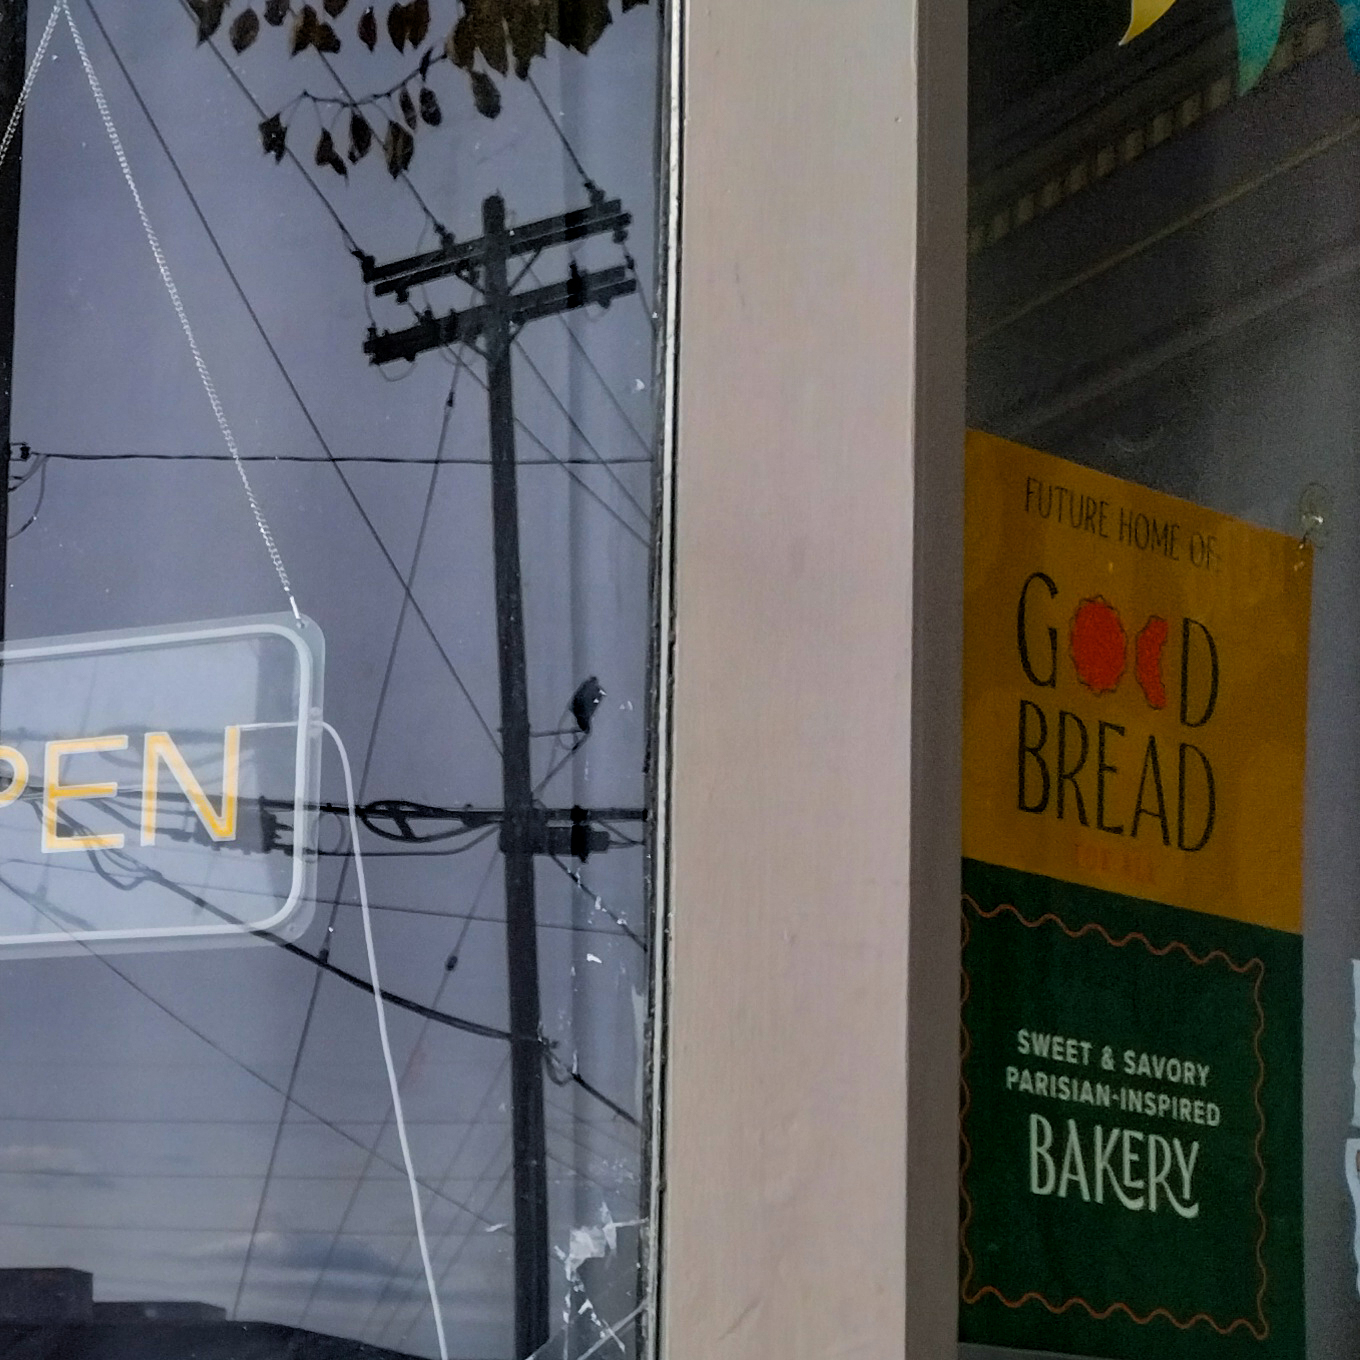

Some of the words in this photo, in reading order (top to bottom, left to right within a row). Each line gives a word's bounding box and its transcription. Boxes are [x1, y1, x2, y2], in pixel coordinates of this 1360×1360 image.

[1024, 475, 1109, 538] FUTURE
[1118, 507, 1180, 561] HOME
[1017, 699, 1217, 852] BREAD
[1005, 1065, 1221, 1127] PARISIAN-INSPIRED
[1017, 1028, 1092, 1066] SWEET
[1100, 1046, 1115, 1072] &
[1123, 1049, 1210, 1087] SAVORY
[1030, 1113, 1200, 1219] BAKERY
